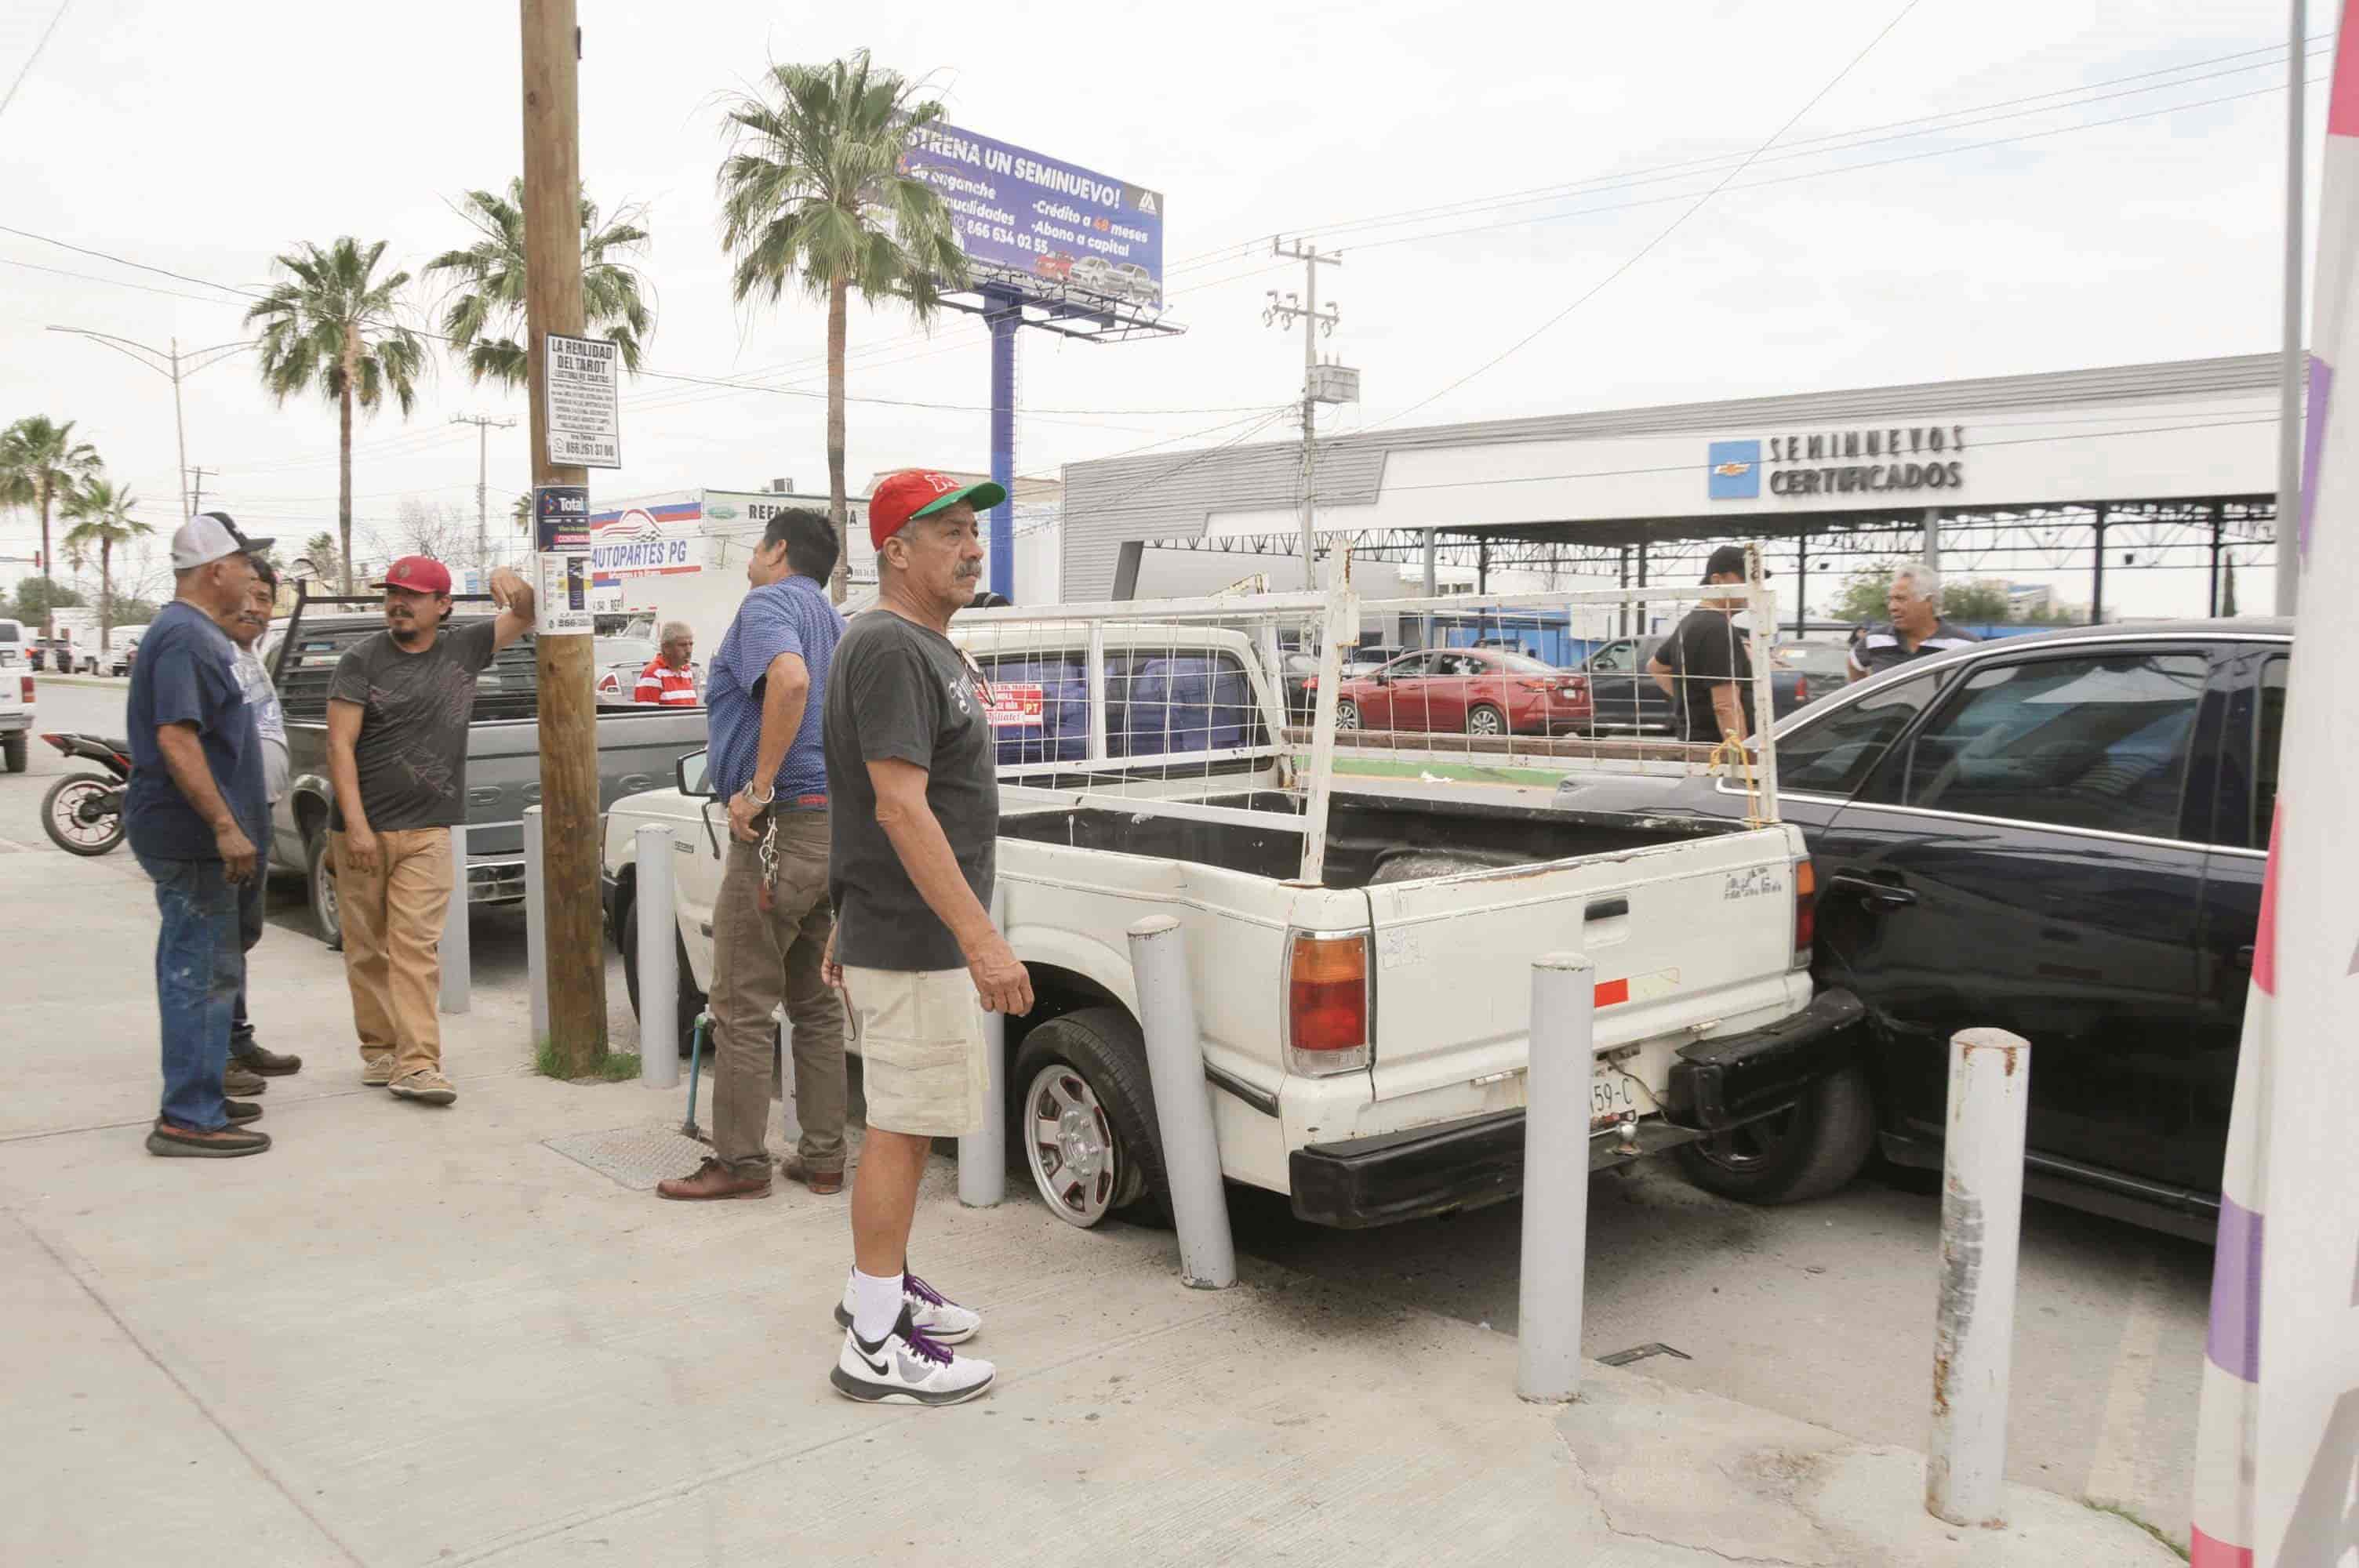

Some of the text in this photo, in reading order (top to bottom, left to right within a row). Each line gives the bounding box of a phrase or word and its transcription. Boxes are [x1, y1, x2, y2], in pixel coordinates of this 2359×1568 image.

[906, 126, 980, 166] STRENA
[984, 147, 1012, 176] UN
[1014, 158, 1121, 209] SEMINUEVO!
[967, 219, 990, 238] 866
[992, 226, 1014, 245] 634
[1017, 232, 1032, 250] 02
[1034, 237, 1049, 255] 55
[1034, 220, 1129, 257] Abono a capital
[1083, 214, 1092, 227] a
[1110, 223, 1148, 244] meses
[552, 338, 612, 360] LA REALIDAD
[558, 355, 606, 374] DEL TAROT
[1770, 425, 1963, 463] SEMINUEVOS
[1770, 462, 1963, 495] CERTIFICADOS
[558, 496, 584, 512] Total
[591, 540, 687, 568] AUTOPARTES PG
[1026, 702, 1040, 713] PT
